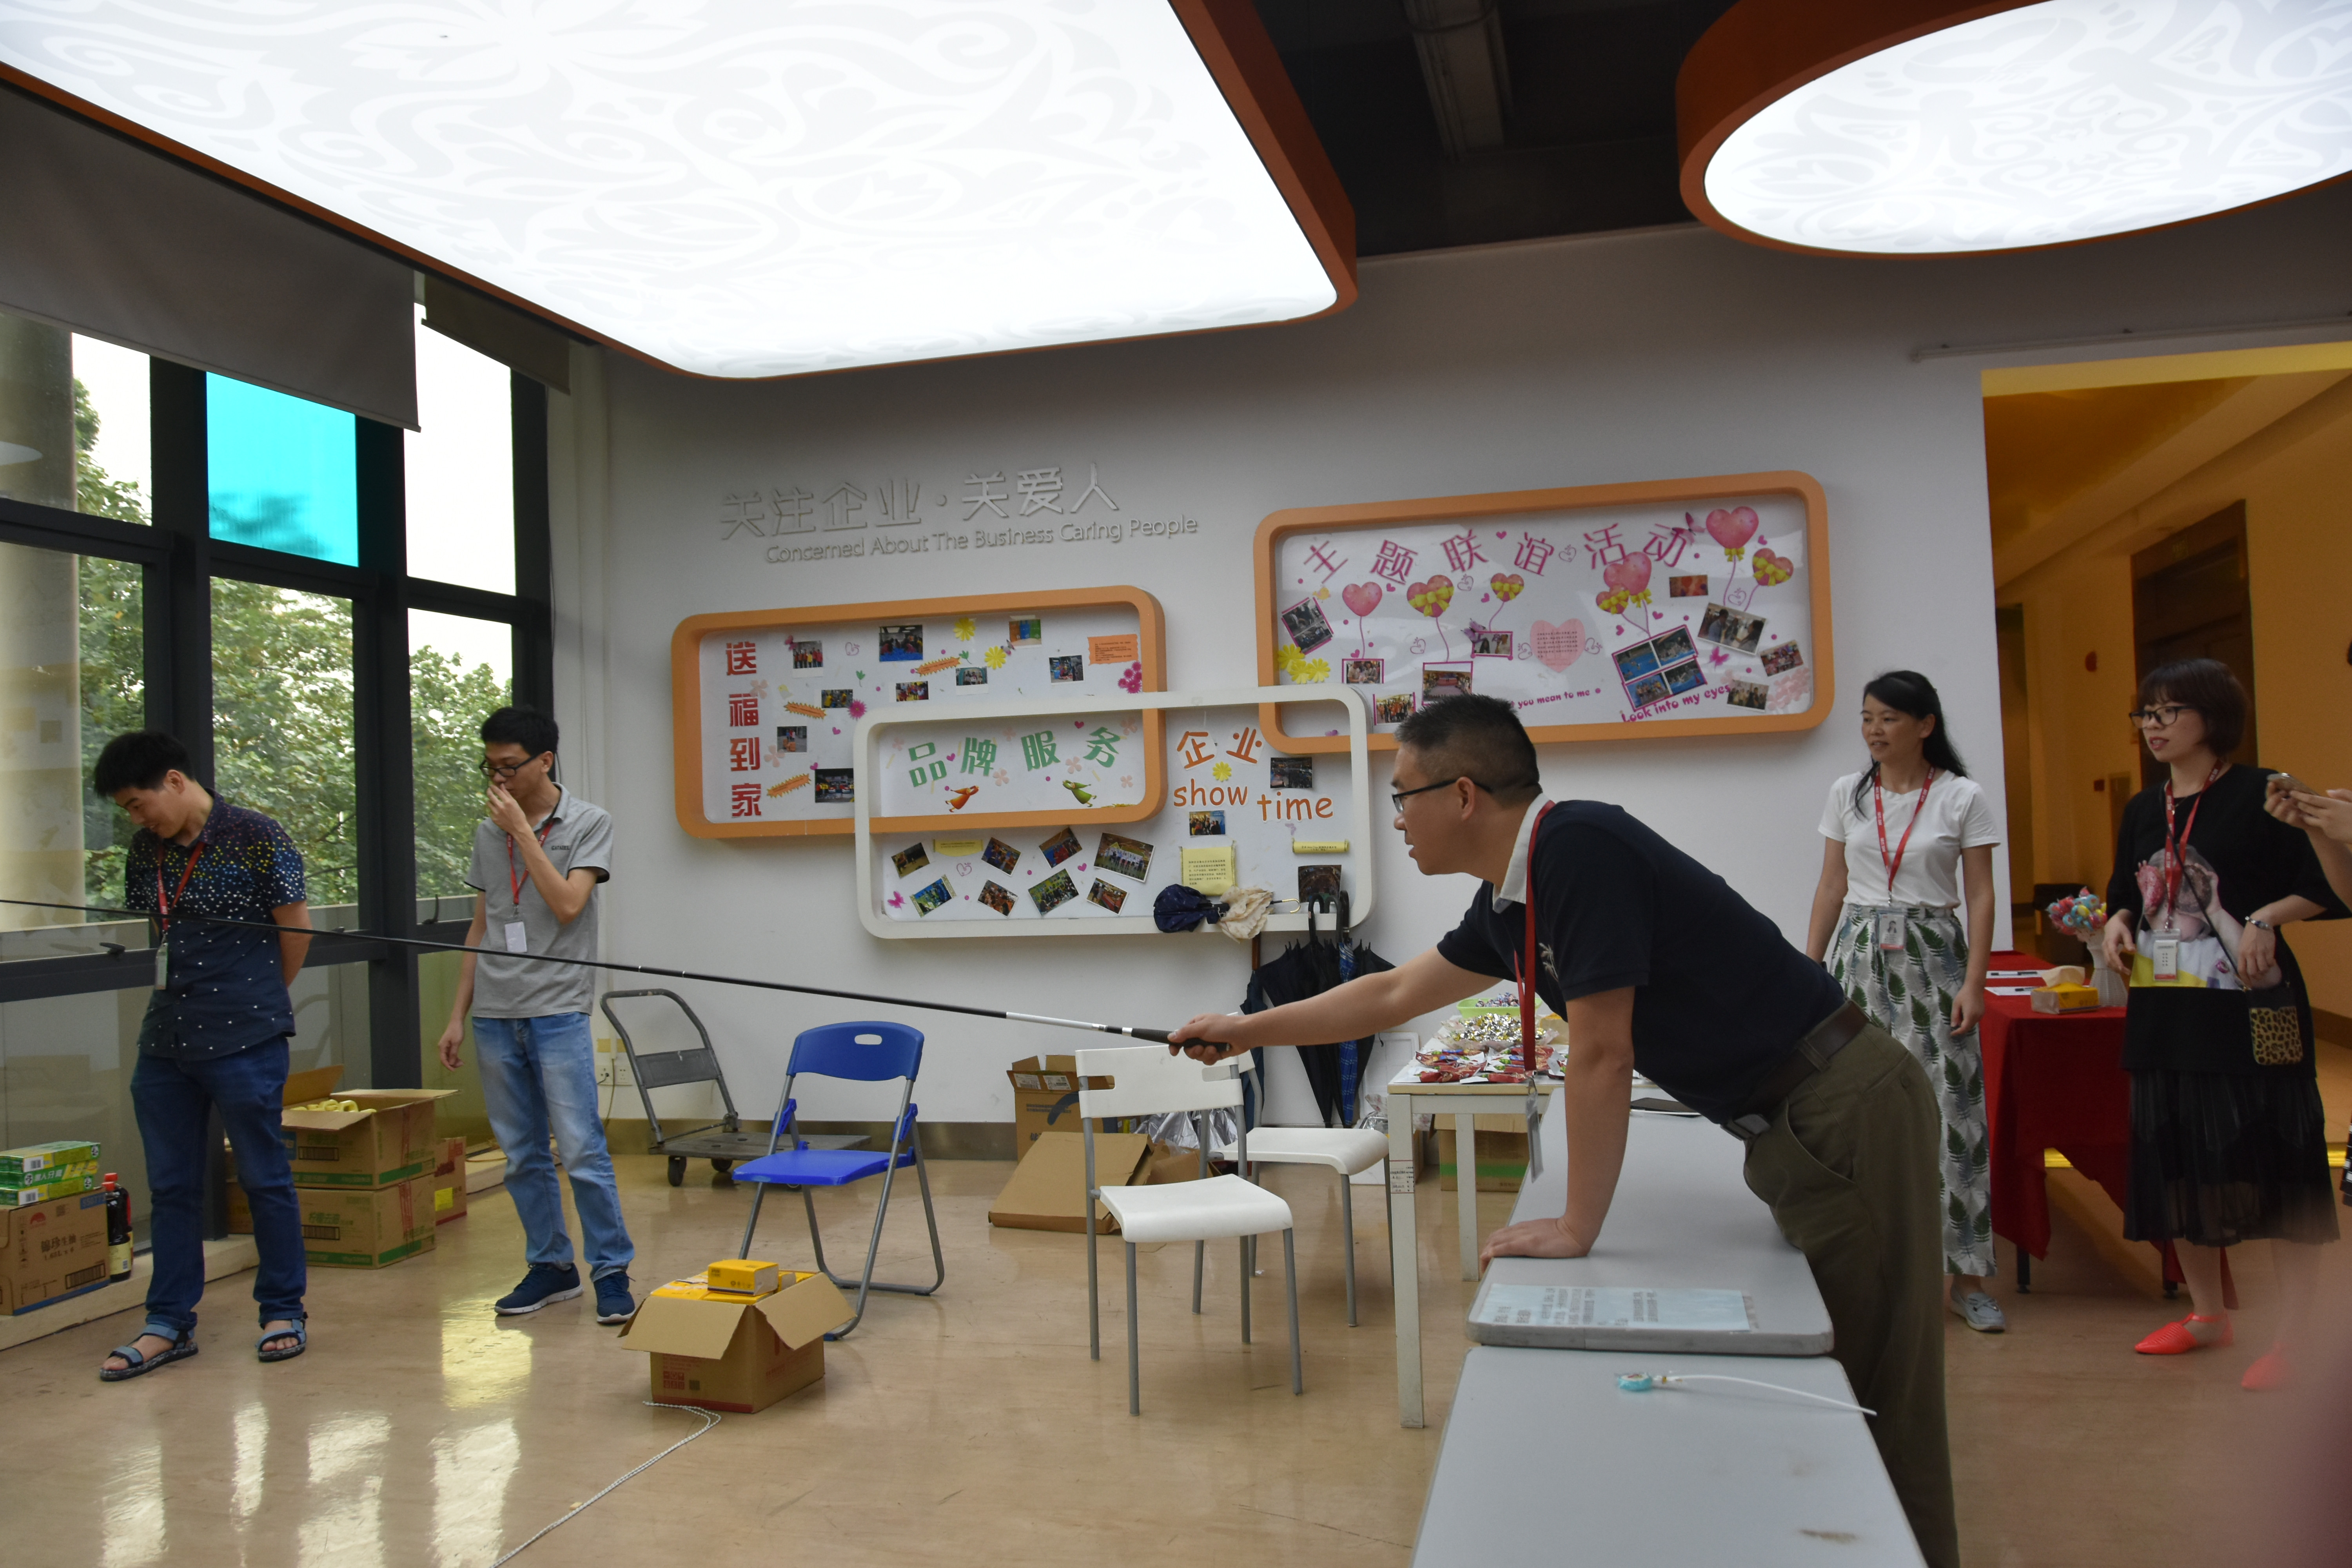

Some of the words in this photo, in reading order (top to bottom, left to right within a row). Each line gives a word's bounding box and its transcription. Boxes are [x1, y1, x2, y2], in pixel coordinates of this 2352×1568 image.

[766, 538, 865, 563] Concerned
[871, 535, 929, 556] About
[932, 531, 968, 550] The
[975, 527, 1054, 548] Business
[1060, 521, 1122, 543] Caring
[1129, 514, 1198, 539] People
[1303, 523, 1689, 586] 主题联谊活动
[1518, 698, 1534, 709] you
[1537, 693, 1561, 704] mean
[1621, 706, 1652, 722] Look
[1655, 701, 1679, 715] into
[1682, 692, 1700, 706] my
[1704, 683, 1731, 700] eyes
[725, 641, 762, 818] 送福到家
[1176, 727, 1262, 769] 企业
[908, 726, 1121, 788] 品牌服务
[1174, 778, 1248, 807] show
[1257, 791, 1333, 821] time
